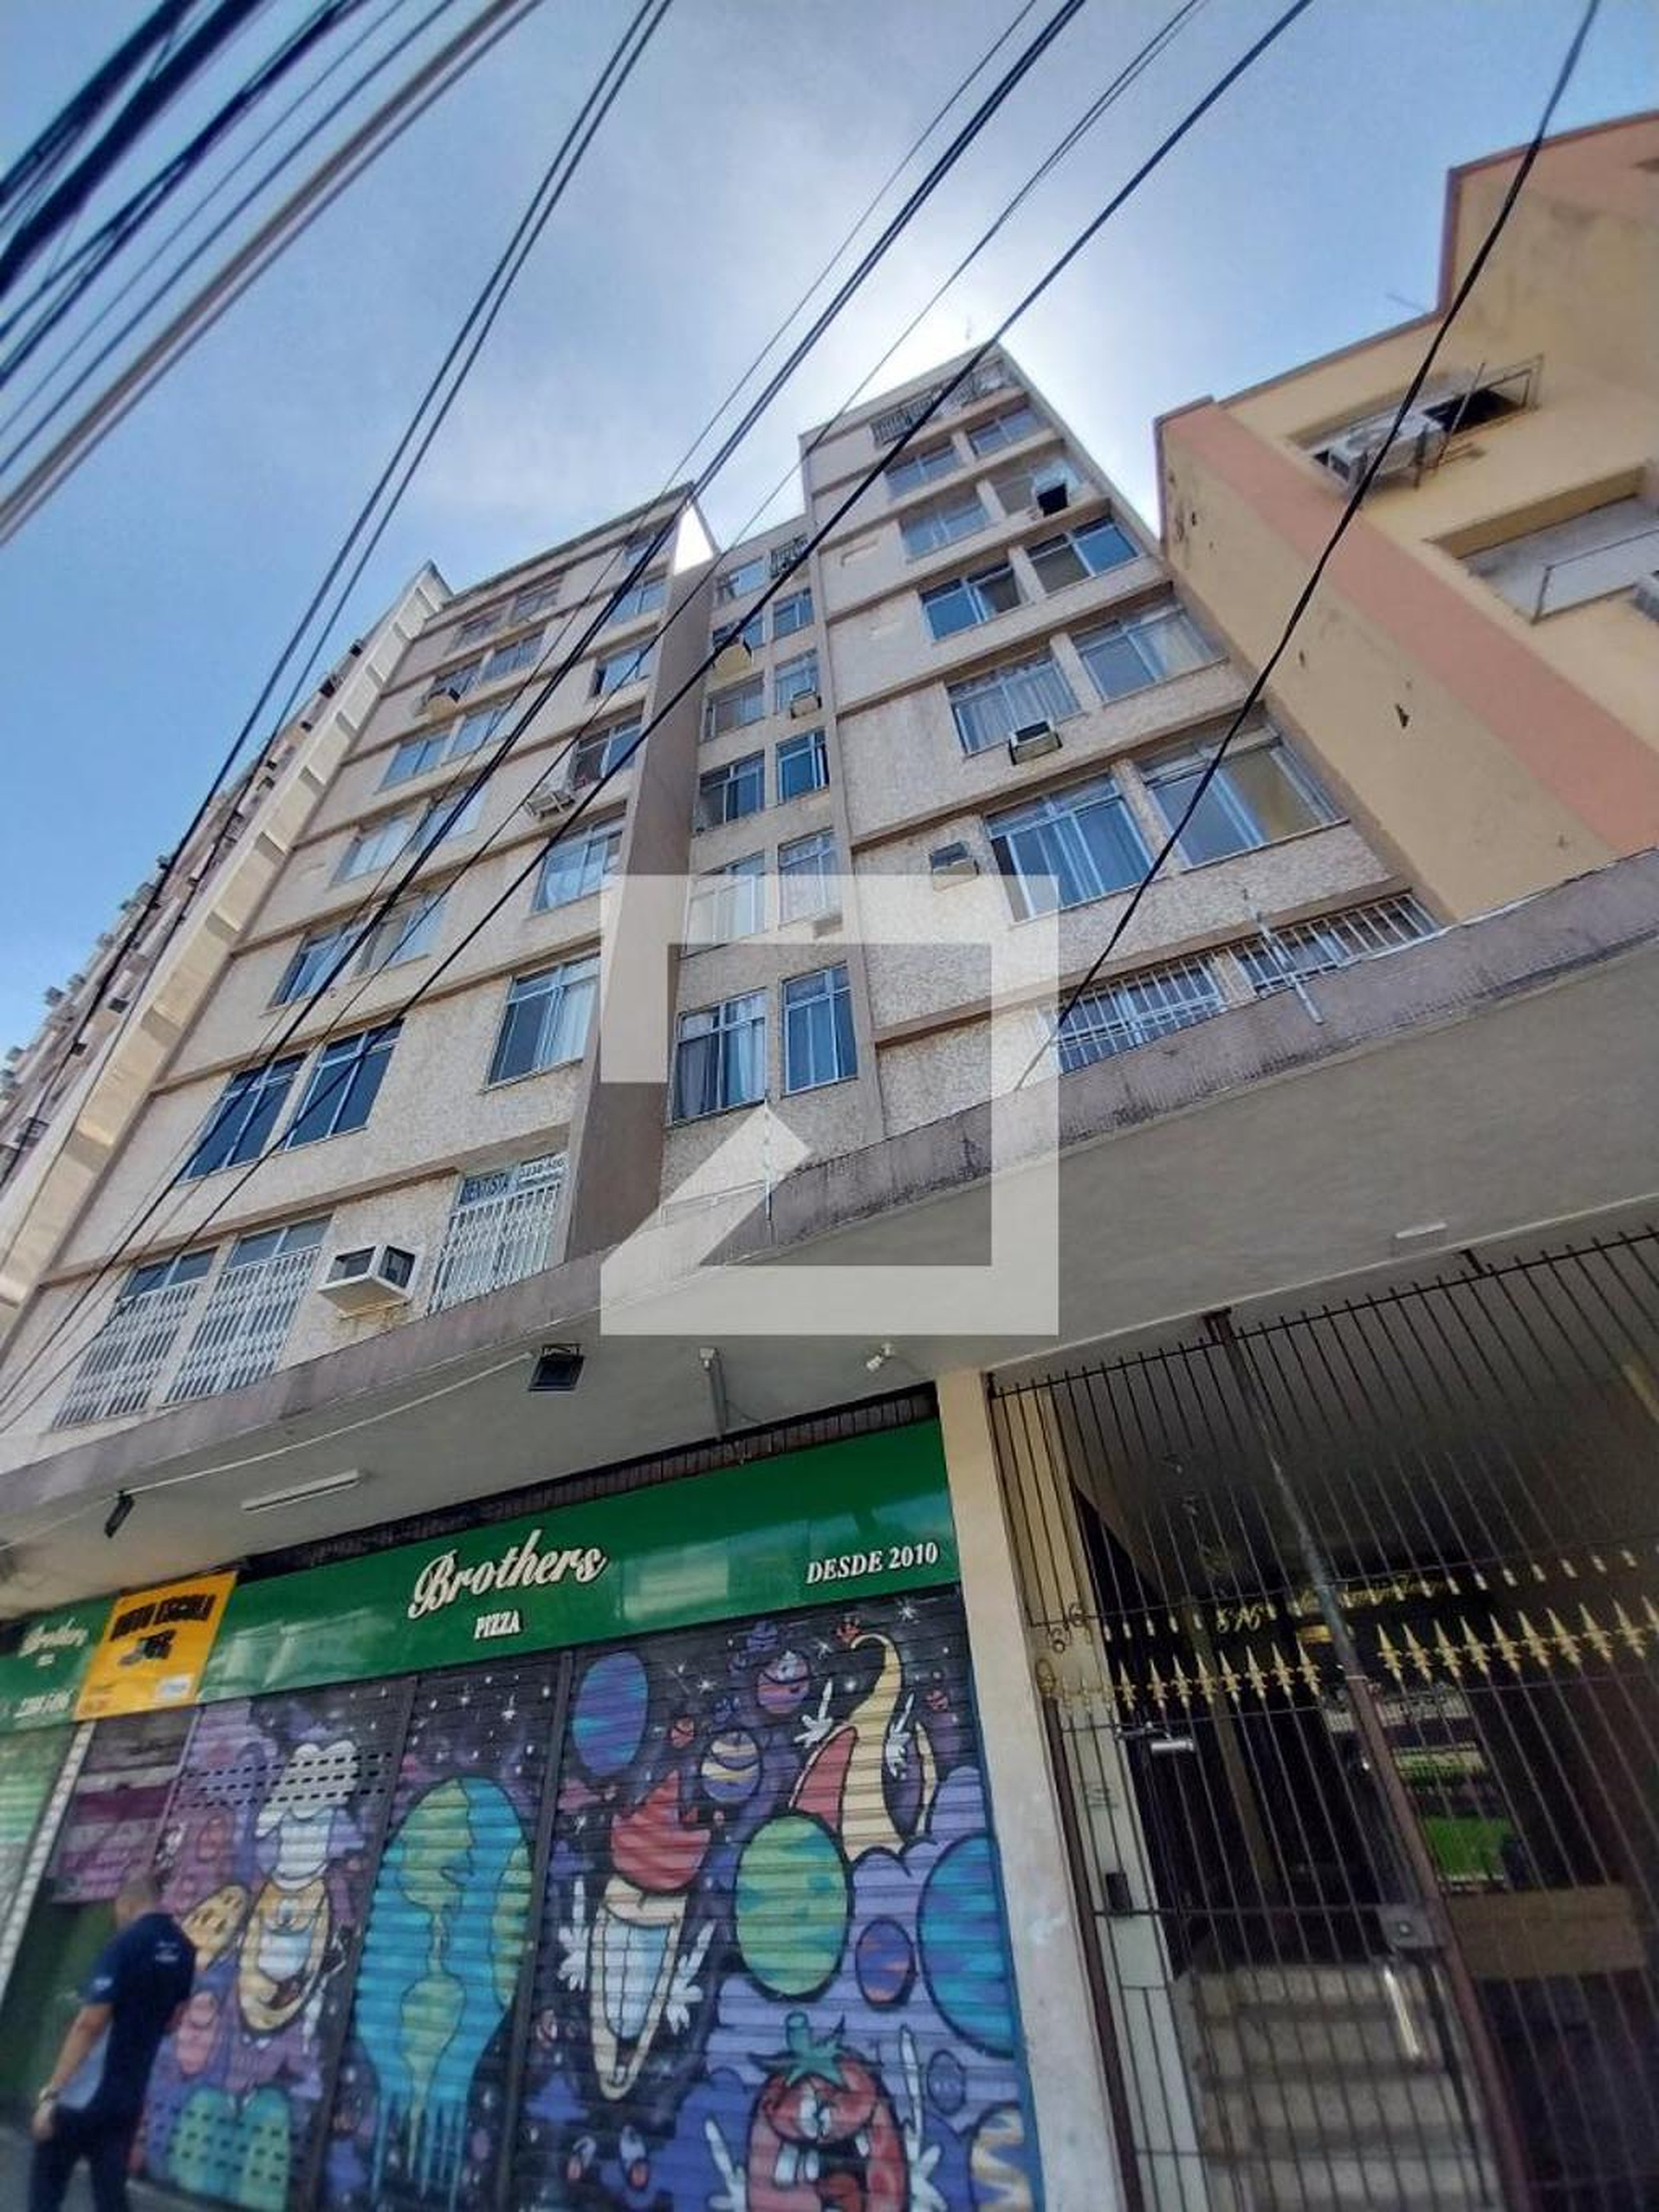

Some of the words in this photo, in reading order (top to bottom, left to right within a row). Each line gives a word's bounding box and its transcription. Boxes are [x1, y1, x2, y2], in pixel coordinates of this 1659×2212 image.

[408, 1528, 607, 1619] Brothers
[806, 1550, 883, 1584] DESDE
[888, 1541, 938, 1569] 2010
[474, 1610, 521, 1639] PIZZA
